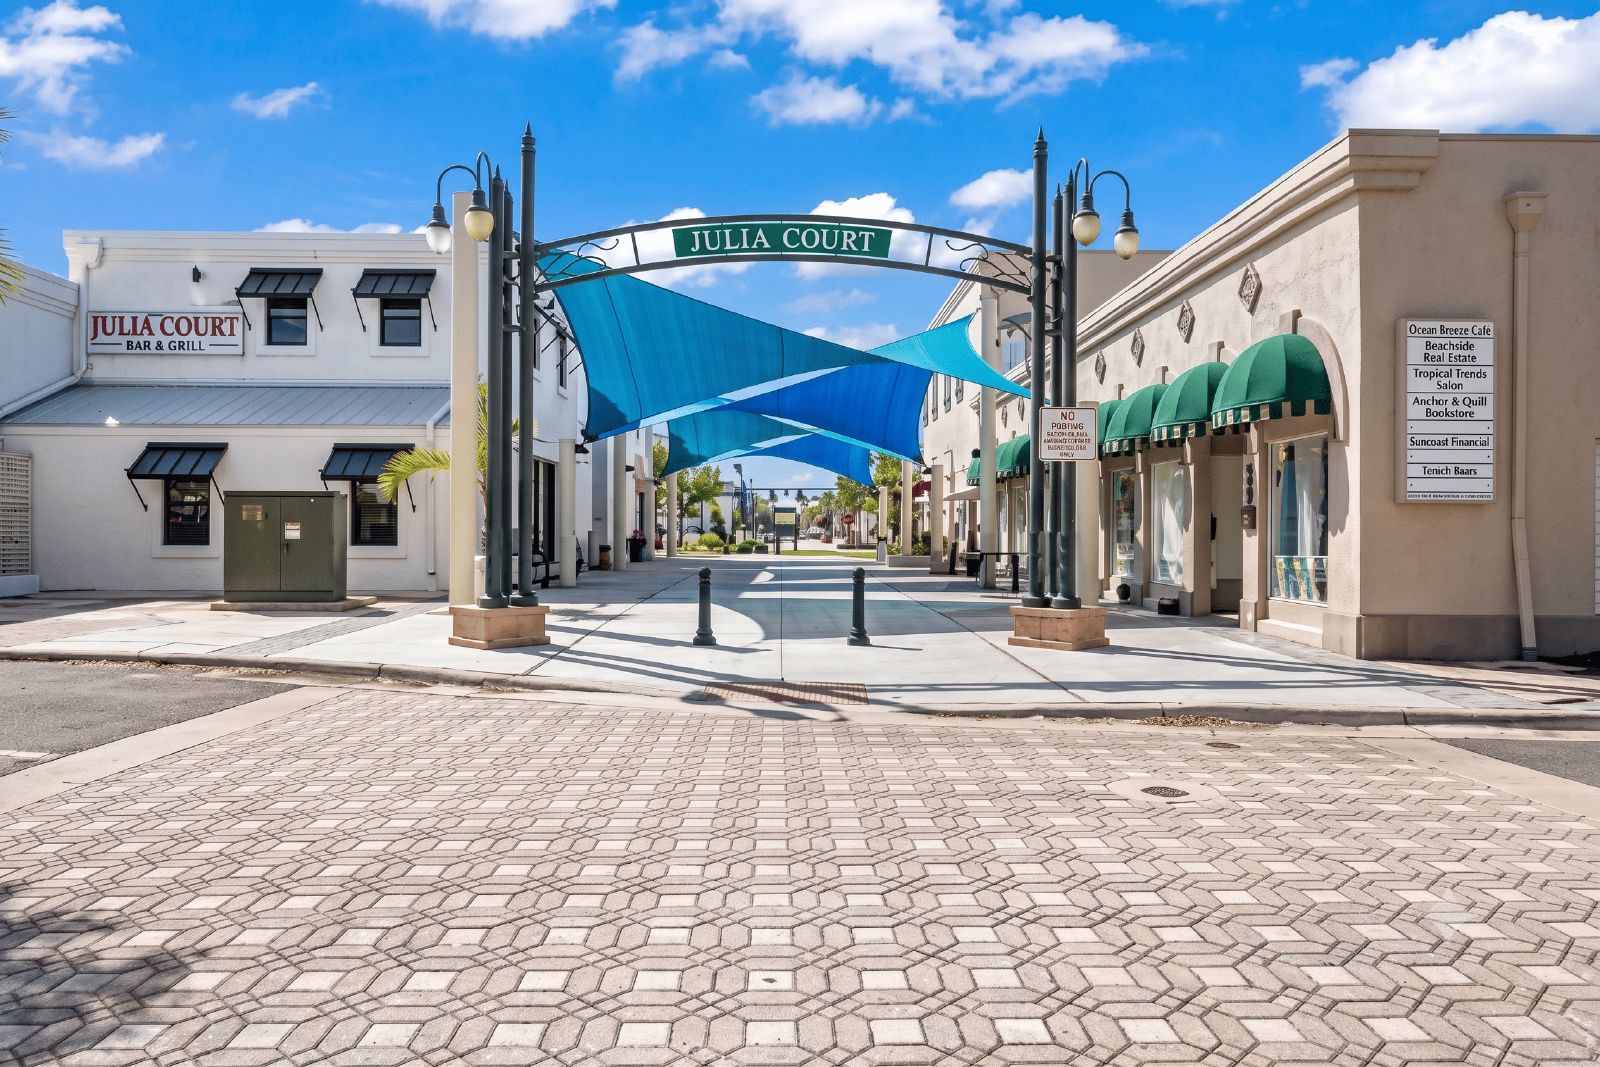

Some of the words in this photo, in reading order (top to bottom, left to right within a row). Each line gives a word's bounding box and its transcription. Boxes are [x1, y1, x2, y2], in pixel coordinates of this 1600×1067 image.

[690, 228, 771, 252] JULIA
[782, 227, 876, 252] COURT
[90, 315, 156, 341] JULIA
[159, 315, 239, 337] COURT
[1409, 324, 1437, 335] Ocean
[1440, 324, 1469, 336] Breeze
[1471, 324, 1491, 336] Café
[126, 340, 152, 350] BAR
[154, 340, 164, 350] &
[168, 340, 206, 351] GRILL
[1425, 340, 1475, 351] Beachside
[1423, 352, 1445, 362] Real
[1448, 352, 1477, 362] Estate
[1413, 368, 1452, 380] Tropical
[1455, 368, 1487, 379] Trends
[1436, 380, 1464, 390] Salon
[1412, 396, 1449, 406] Anchor
[1452, 396, 1460, 406] &
[1462, 396, 1487, 407] Quill
[1060, 412, 1075, 420] NO
[1425, 408, 1475, 418] Bookstore
[1409, 436, 1449, 447] Suncoast
[1451, 436, 1490, 447] Financial
[1422, 466, 1451, 476] Tenich
[1454, 466, 1478, 476] Baars
